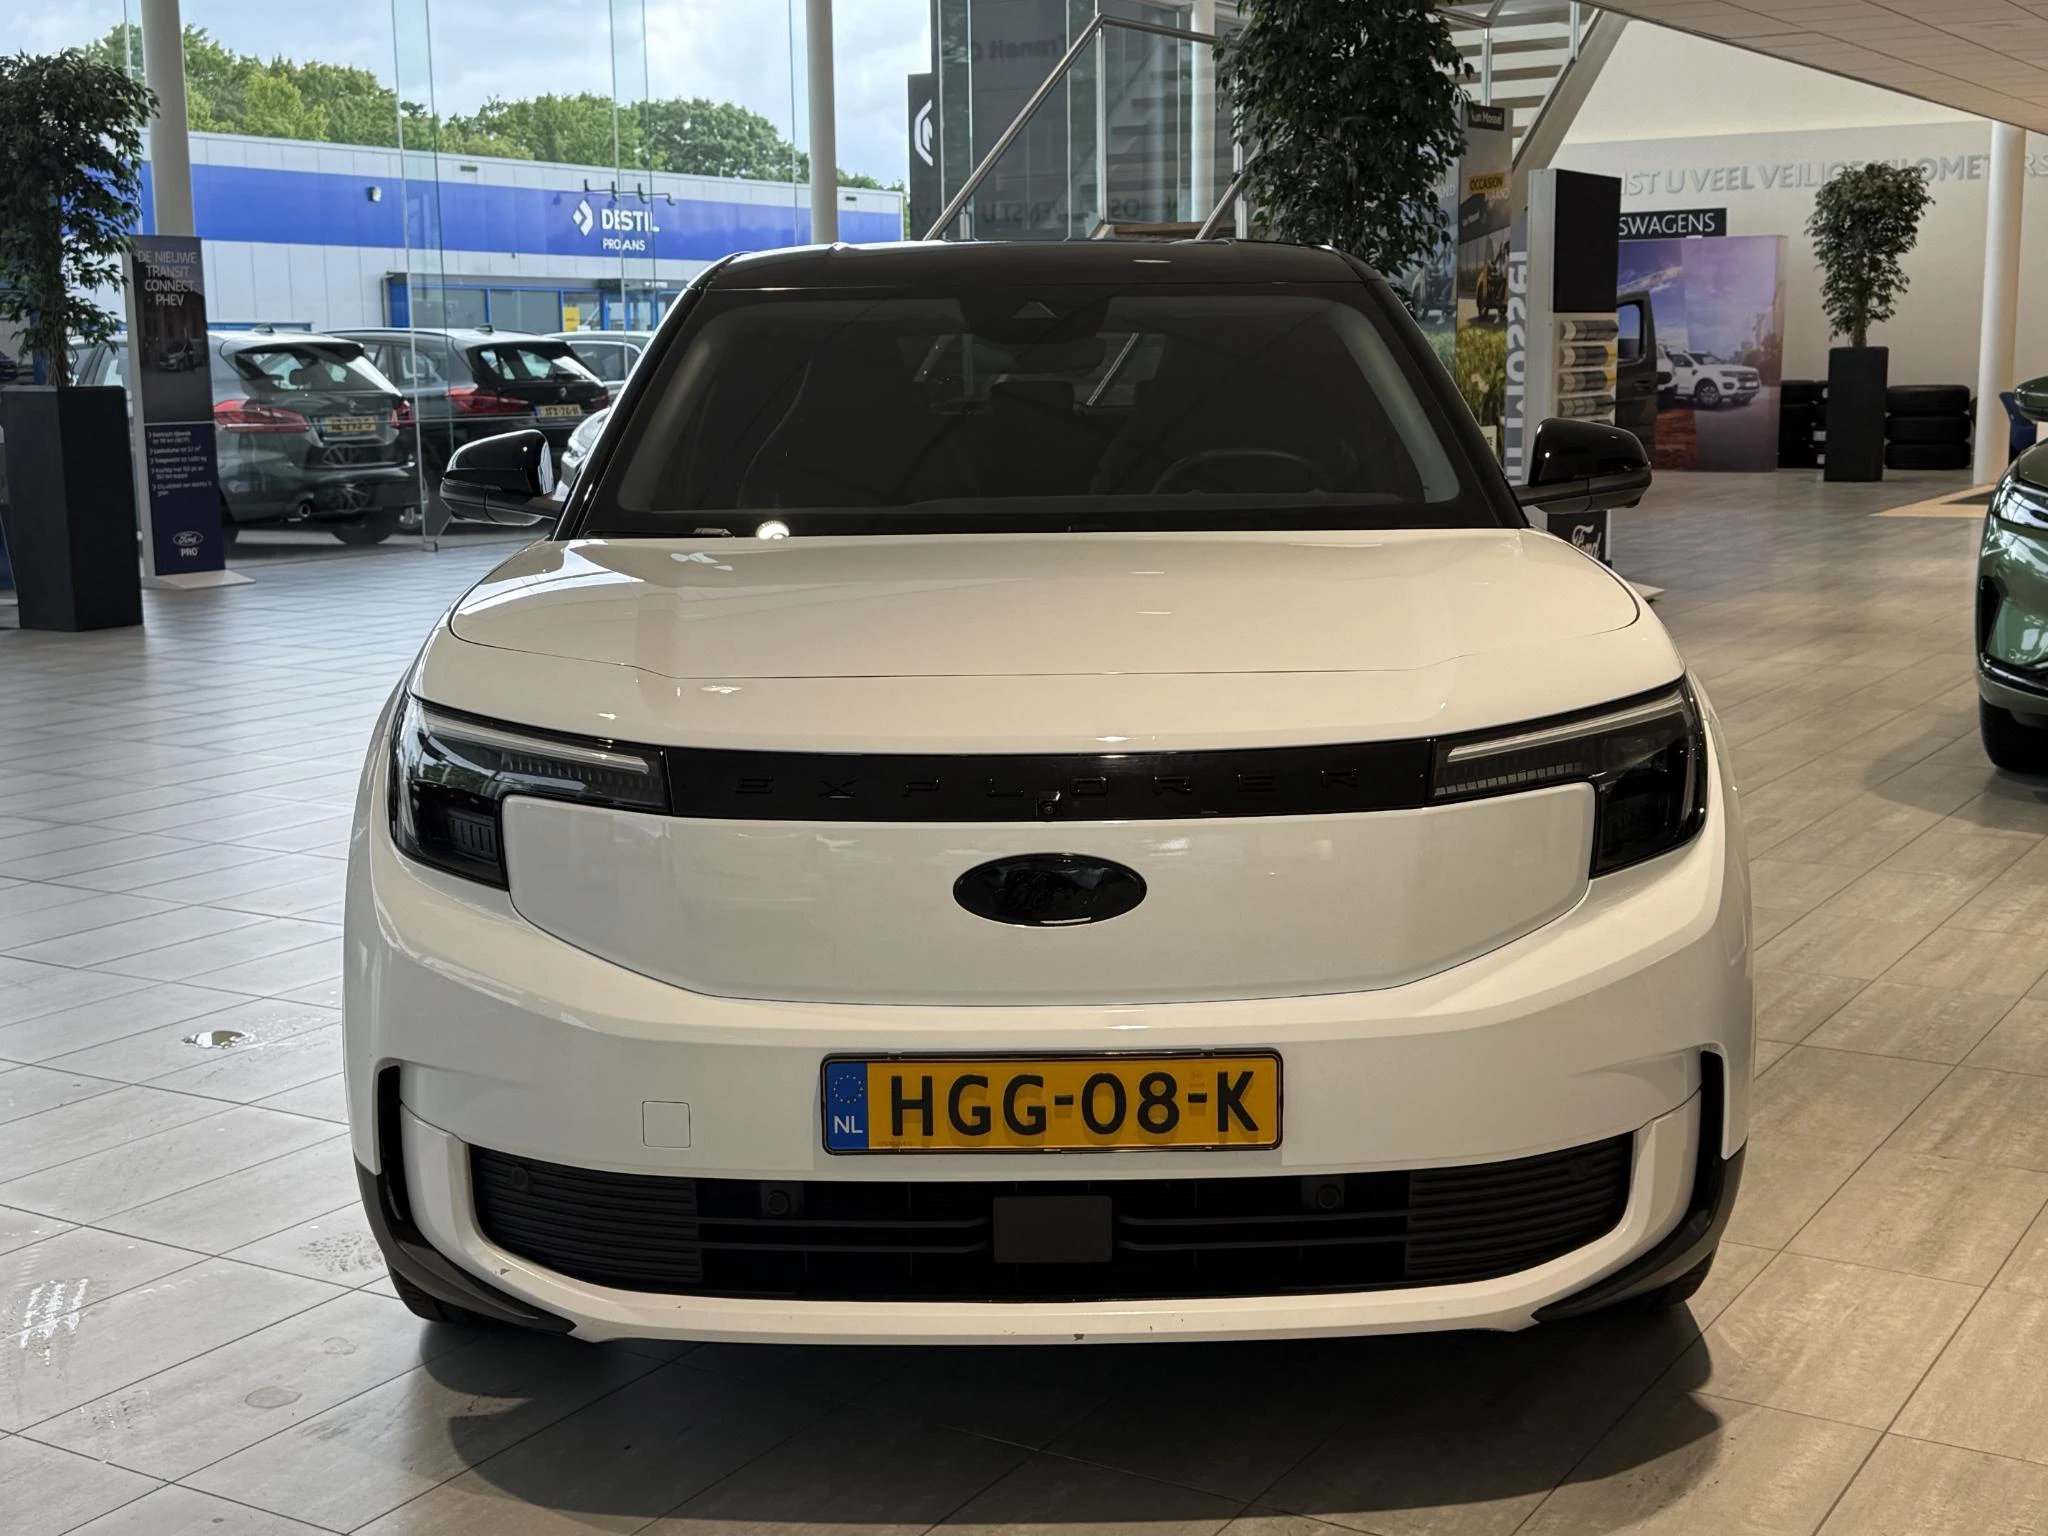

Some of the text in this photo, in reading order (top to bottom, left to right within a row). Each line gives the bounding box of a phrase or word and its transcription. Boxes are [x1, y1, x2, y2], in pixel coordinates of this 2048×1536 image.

[1470, 175, 1503, 191] OCCASION
[1665, 168, 1685, 194] U
[1689, 166, 1754, 192] VEEL
[601, 209, 660, 232] DESTIL
[1619, 212, 1715, 236] SWAGENS
[602, 238, 646, 251] PROANS
[137, 250, 198, 264] DE NIEUWE
[145, 265, 191, 278] TRANSIT
[144, 280, 195, 292] CONNECT
[155, 293, 185, 306] PHEV
[181, 547, 198, 557] PRO
[734, 766, 1359, 798] EXPLORER
[891, 1070, 1259, 1137] HGG-08-K
[833, 1115, 864, 1135] NL
